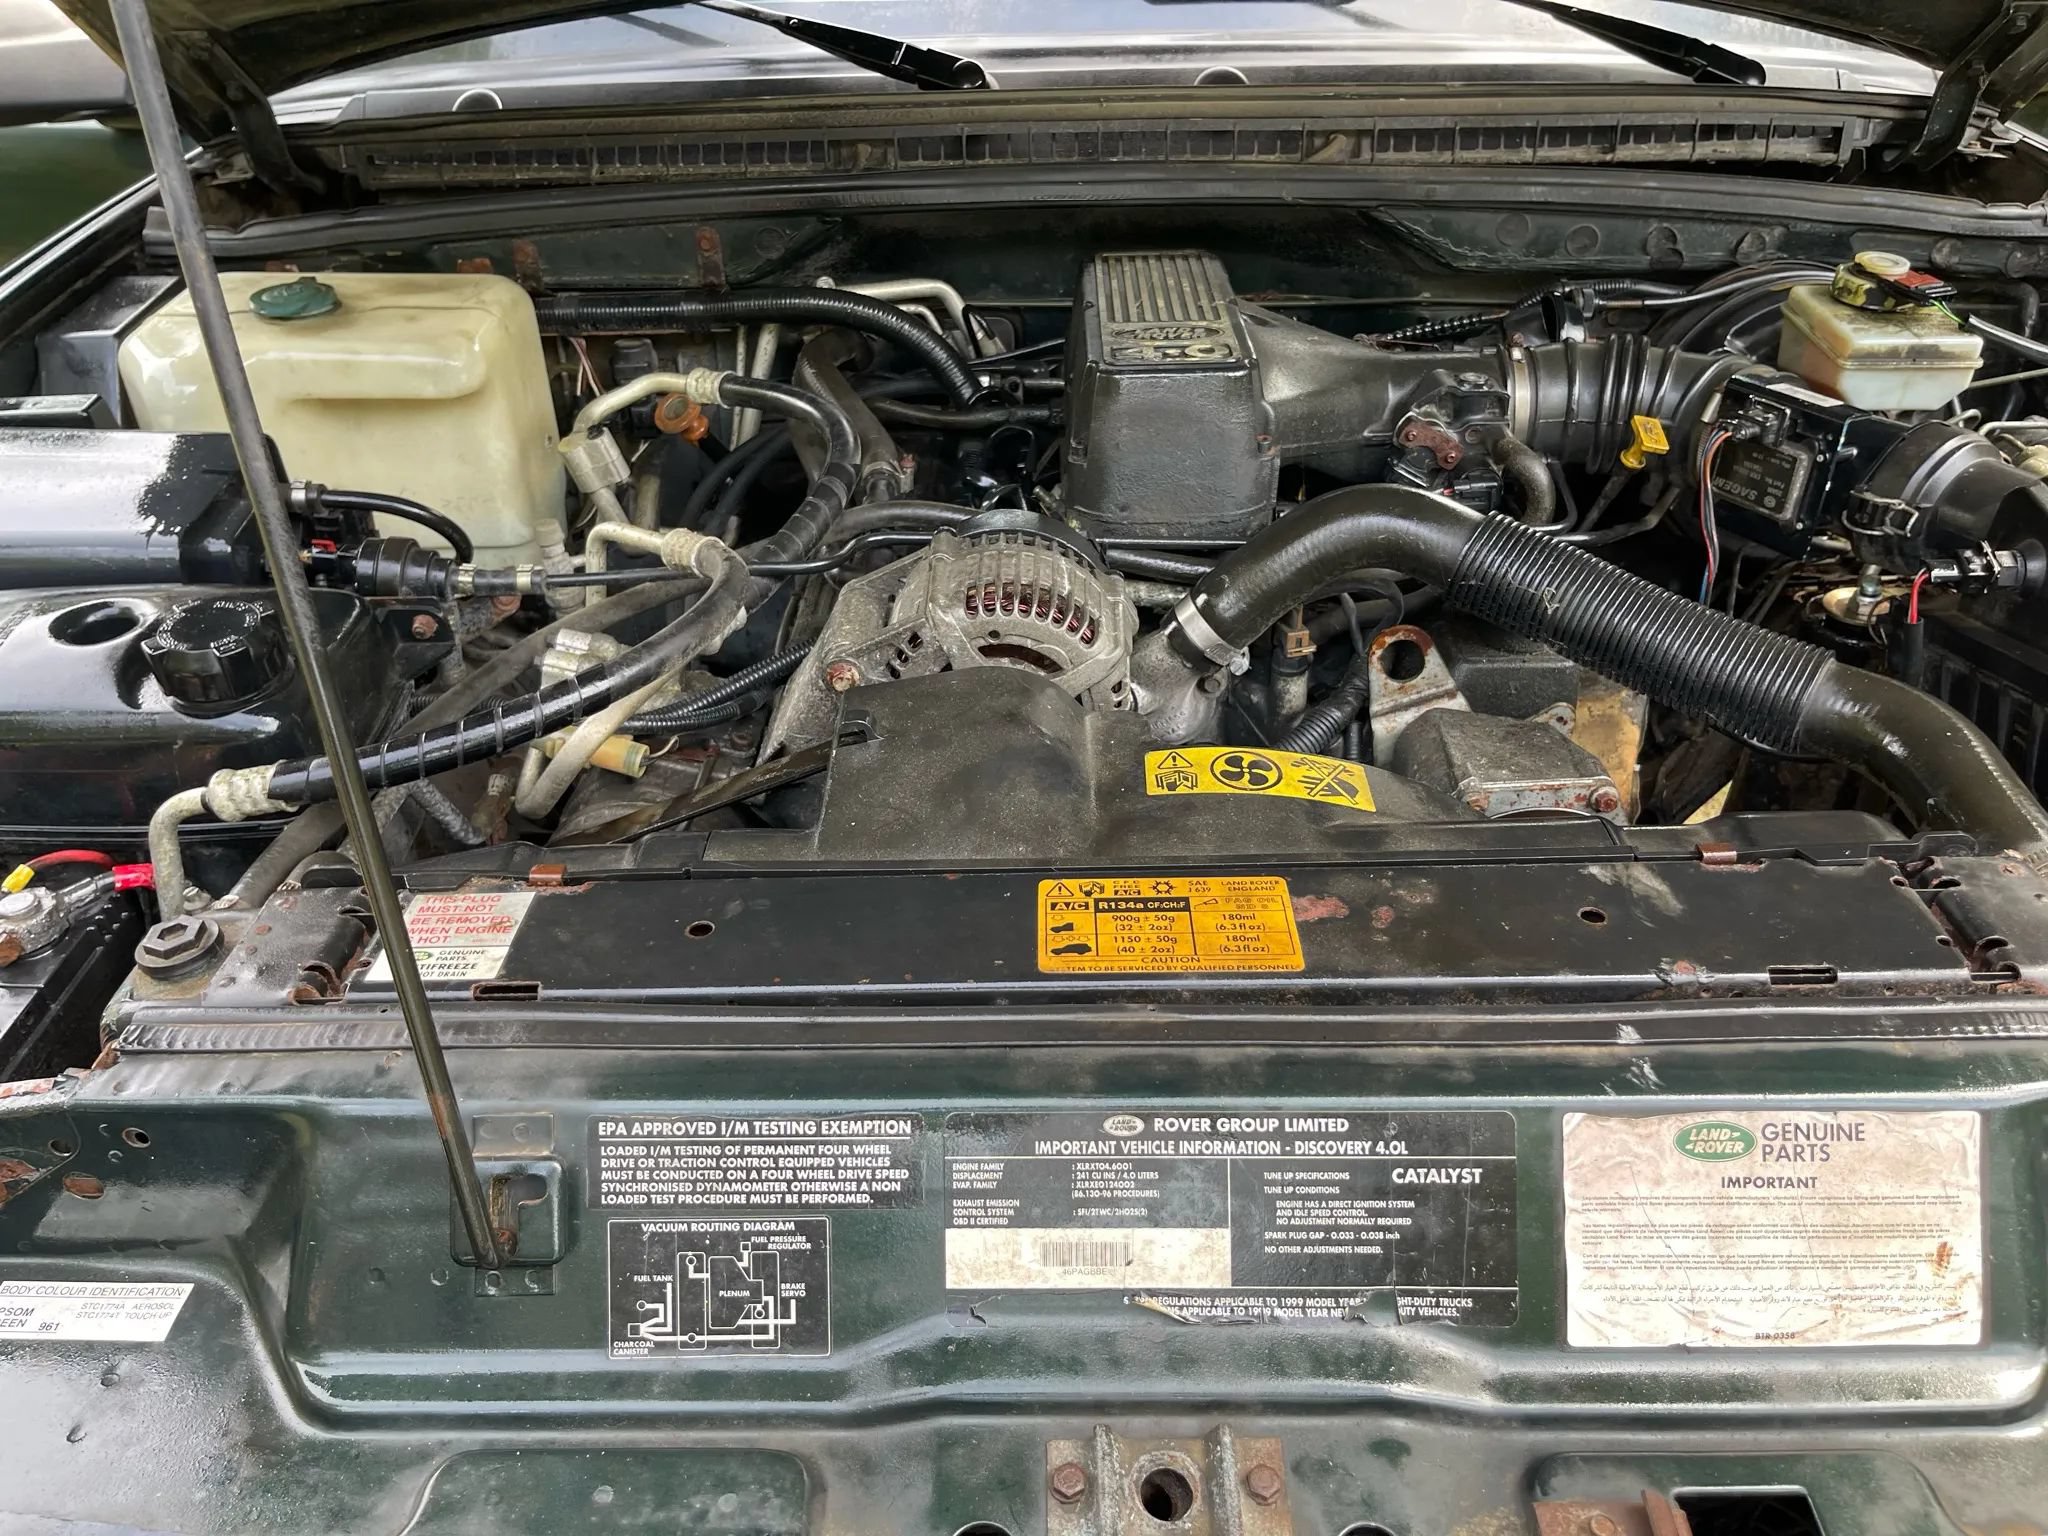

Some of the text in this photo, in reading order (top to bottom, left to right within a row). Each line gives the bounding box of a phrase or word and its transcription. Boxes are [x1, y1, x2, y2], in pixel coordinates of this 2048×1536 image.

[1712, 477, 1757, 500] SAGEM
[418, 905, 496, 913] MUST NOT
[1054, 902, 1086, 910] A/C
[1099, 902, 1144, 910] R134a
[411, 916, 430, 925] BE
[1112, 915, 1175, 923] 900g 50g
[1222, 913, 1255, 921] 180ml
[455, 926, 513, 934] ENGINE
[1115, 923, 1173, 932] (32 2oz)
[1156, 936, 1177, 945] 50g
[599, 1120, 911, 1137] EPA APPROVED I/M TESTING EXEMPTION
[1154, 1118, 1349, 1132] ROVER GROUP LIMITED
[1690, 1129, 1732, 1140] LAND
[1761, 1123, 1865, 1141] GENUINE
[601, 1145, 892, 1156] LOADED I/M TESTING OF PERMANENT FOUR WHEEL
[1035, 1140, 1408, 1155] IMPORTANT VEHICLE INFORMATION DISCOVERY 4.0L
[1694, 1141, 1745, 1153] ROVER
[1762, 1144, 1830, 1162] PARTS
[601, 1157, 890, 1168] DRIVE OR TRACTION CONTROL EQUIPPED VEHICLES
[953, 1163, 1004, 1171] ENGINE FAMILY
[601, 1169, 909, 1180] MUST BE CONDUCTED ON FOUR WHEEL DRIVE SPEED
[1264, 1172, 1350, 1180] TUNE UP SPECIFICATIONS
[1391, 1168, 1482, 1184] CATALYST
[601, 1181, 901, 1192] SYNCHRONISED DYNAMOMETER OTHERWISE NON
[1722, 1177, 1817, 1189] IMPORTANT
[1264, 1186, 1340, 1194] TUNE UP CONDITIONS
[601, 1193, 873, 1204] LOADED TEST PROCEDURE MUST BE PERFORMED.
[1276, 1209, 1368, 1217] AND IDLE SPEED CONTROL.
[641, 1222, 795, 1232] VACUUM ROUTING DIAGRAM
[1, 1285, 184, 1296] BODY COLOUR IDENTIFICATION
[132, 1302, 175, 1310] AEROSOL
[1215, 1297, 1263, 1306] APPLICABLE
[1266, 1298, 1278, 1306] TO
[1281, 1298, 1303, 1307] 1999
[1306, 1298, 1336, 1307] MODEL
[1439, 1297, 1473, 1307] TRUCKS
[0, 1319, 60, 1331] EEN 961
